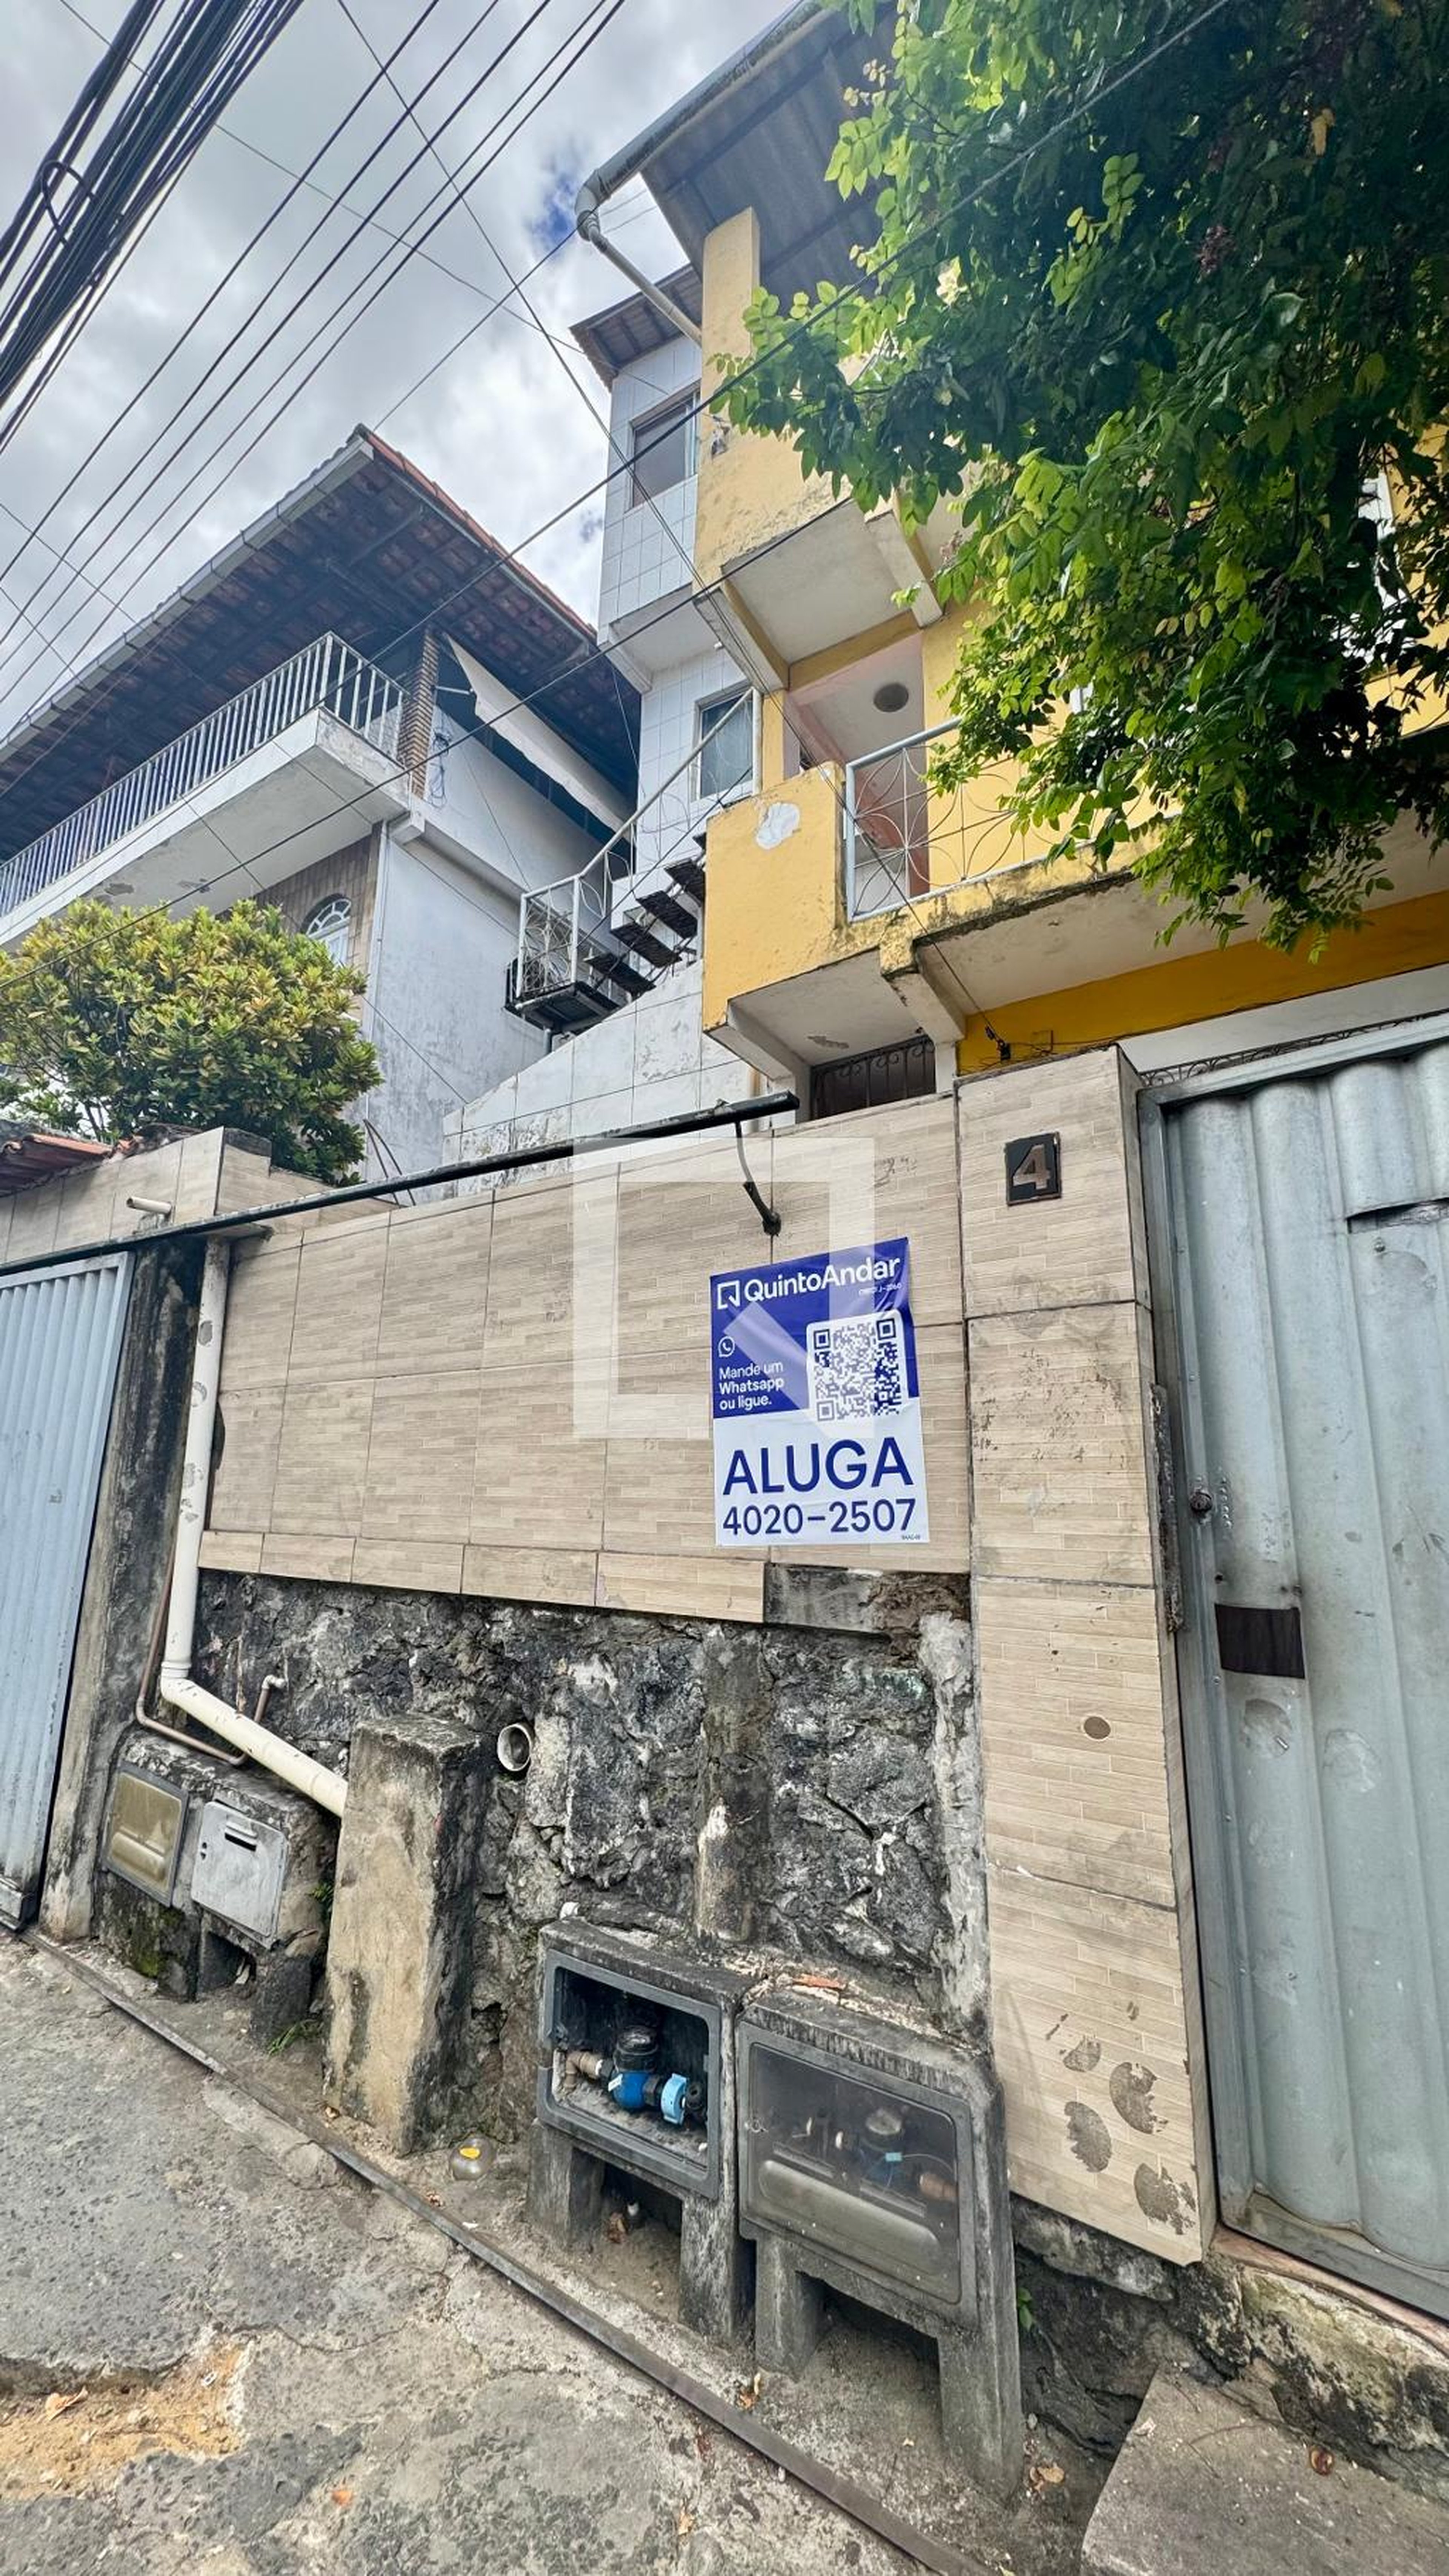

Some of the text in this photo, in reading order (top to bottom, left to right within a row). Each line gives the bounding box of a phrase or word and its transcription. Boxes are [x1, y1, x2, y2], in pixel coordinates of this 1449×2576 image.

[1013, 1144, 1051, 1189] 4
[744, 1257, 900, 1302] QuintoAndar
[719, 1362, 783, 1380] Mande um
[719, 1378, 784, 1395] Whatsapp
[720, 1395, 772, 1411] ou ligue.
[723, 1437, 914, 1495] ALUGA
[723, 1498, 916, 1535] 4020-2507
